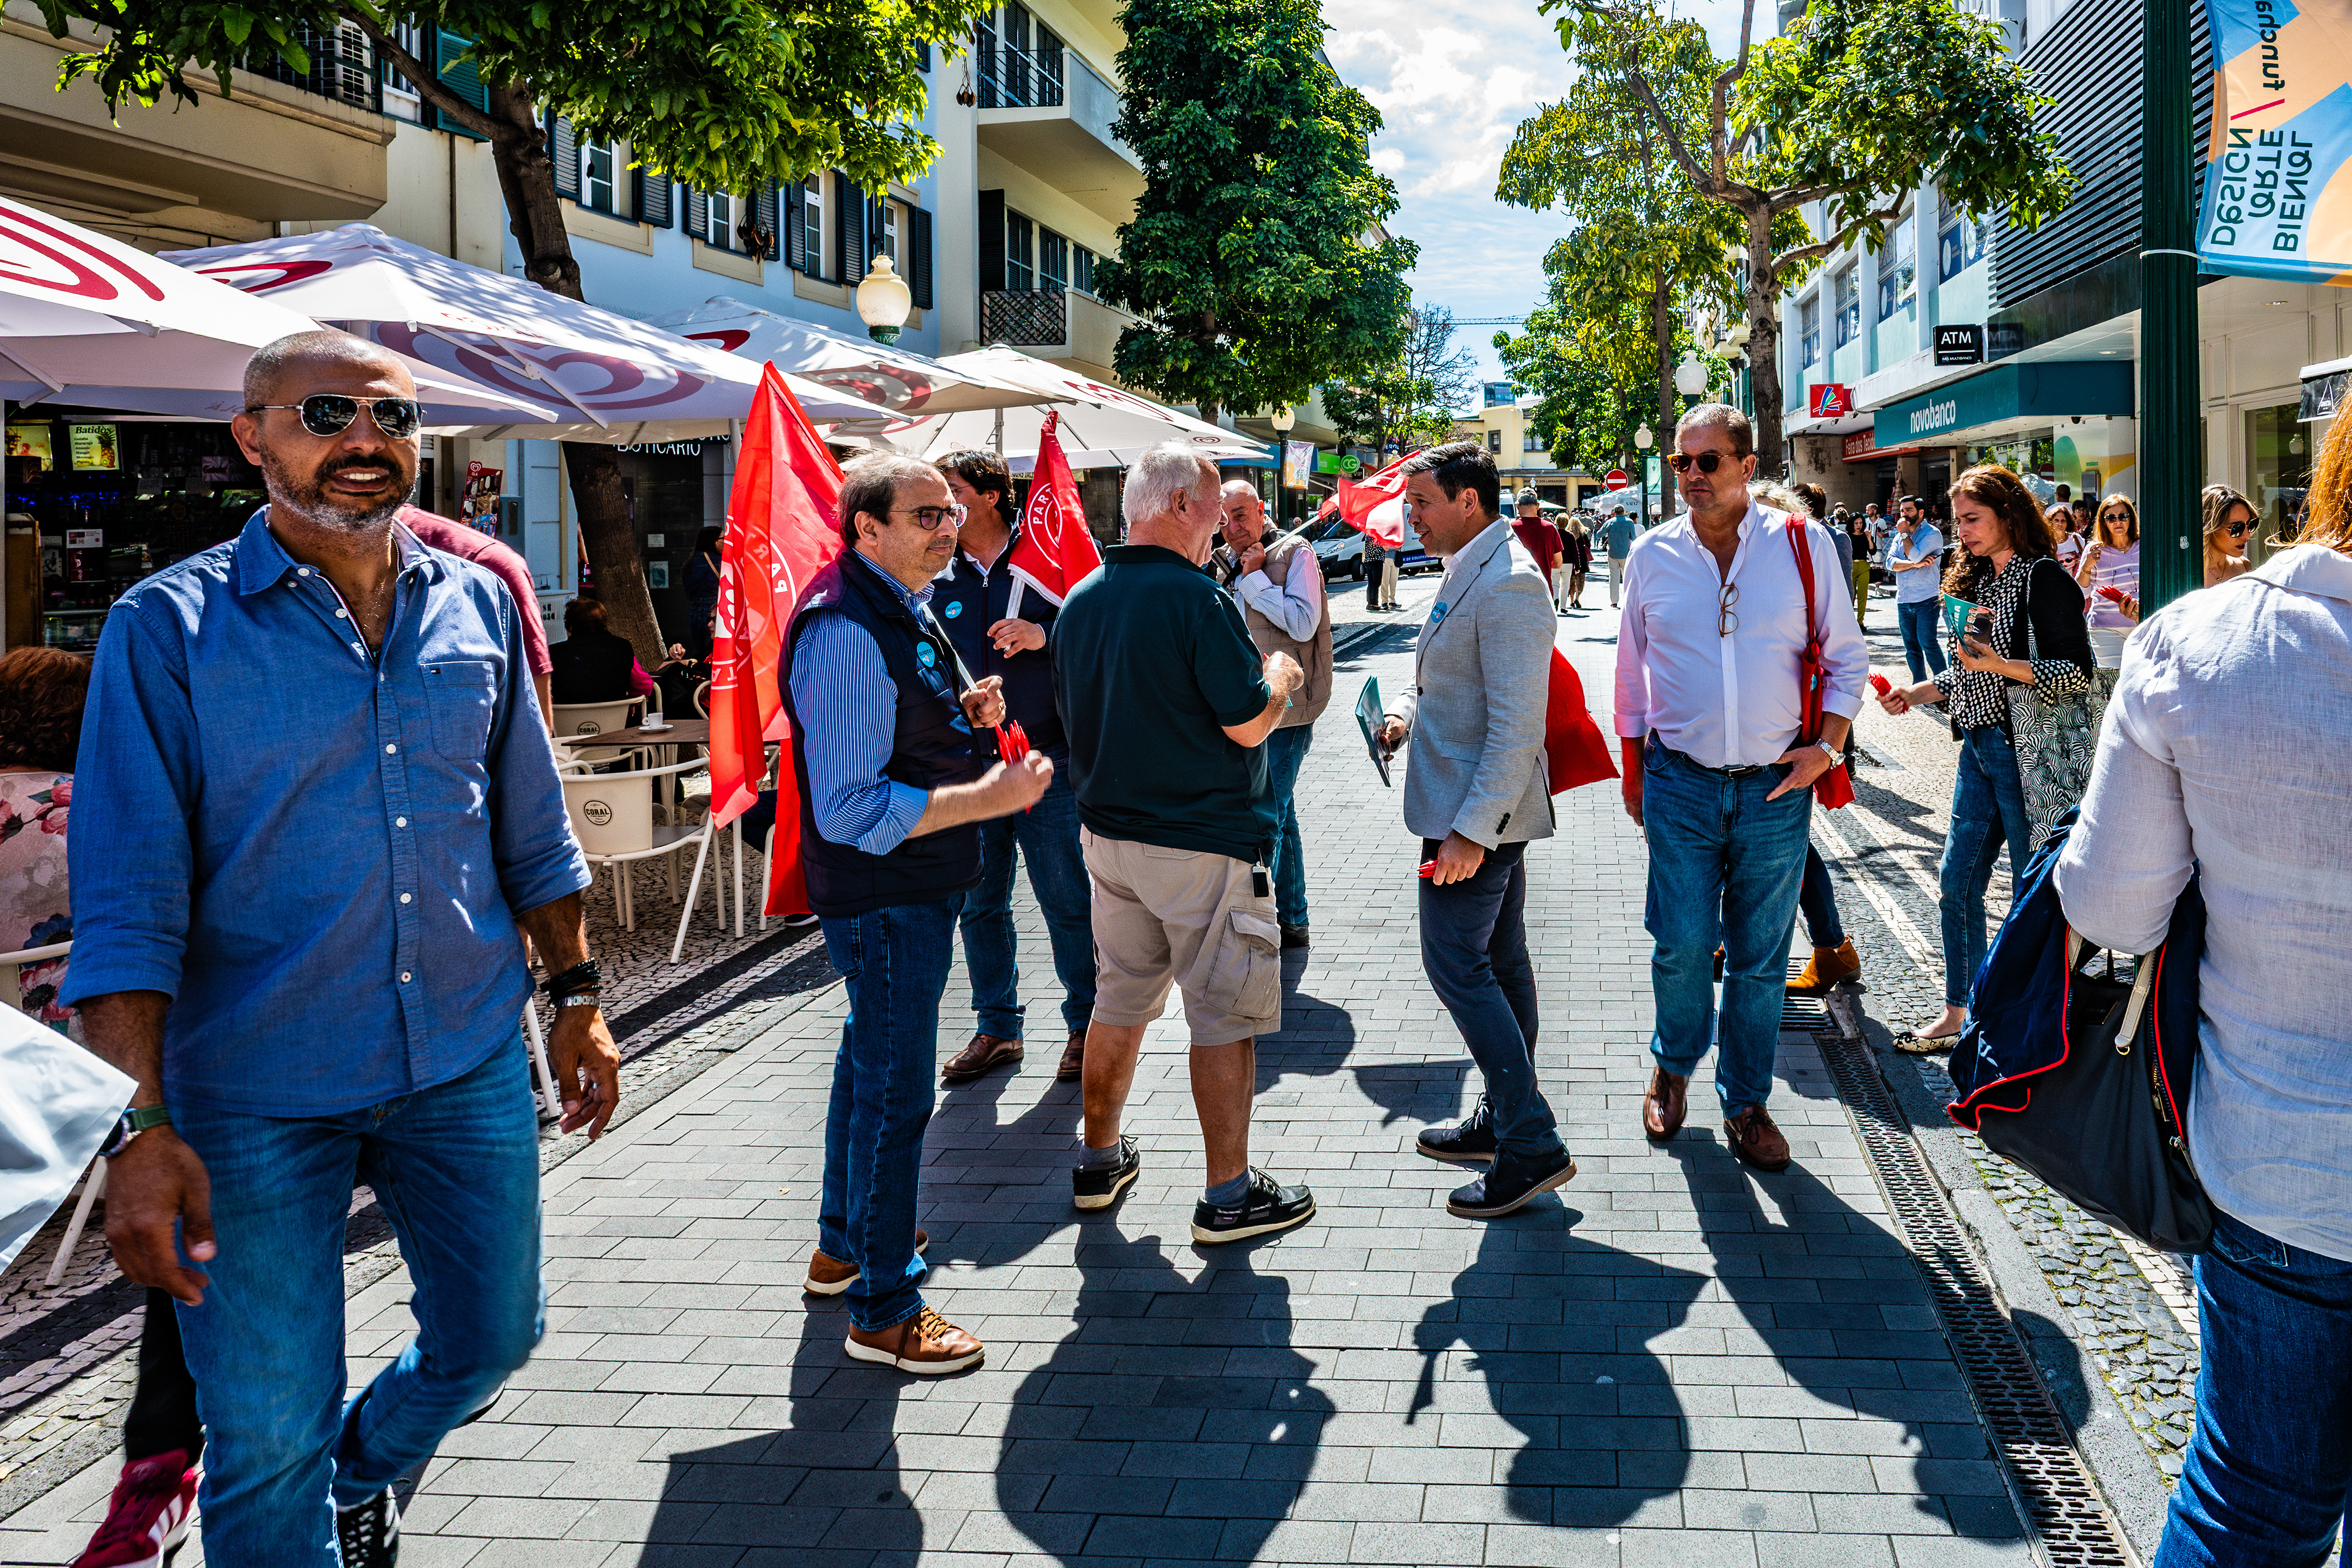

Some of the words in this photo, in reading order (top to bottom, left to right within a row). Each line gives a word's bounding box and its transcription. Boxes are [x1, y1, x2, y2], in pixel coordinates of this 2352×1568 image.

[1941, 331, 1972, 345] ATM
[1910, 398, 1956, 434] novobanco
[75, 426, 112, 434] Batidos
[1845, 438, 1855, 455] Feira
[1342, 459, 1357, 469] CG
